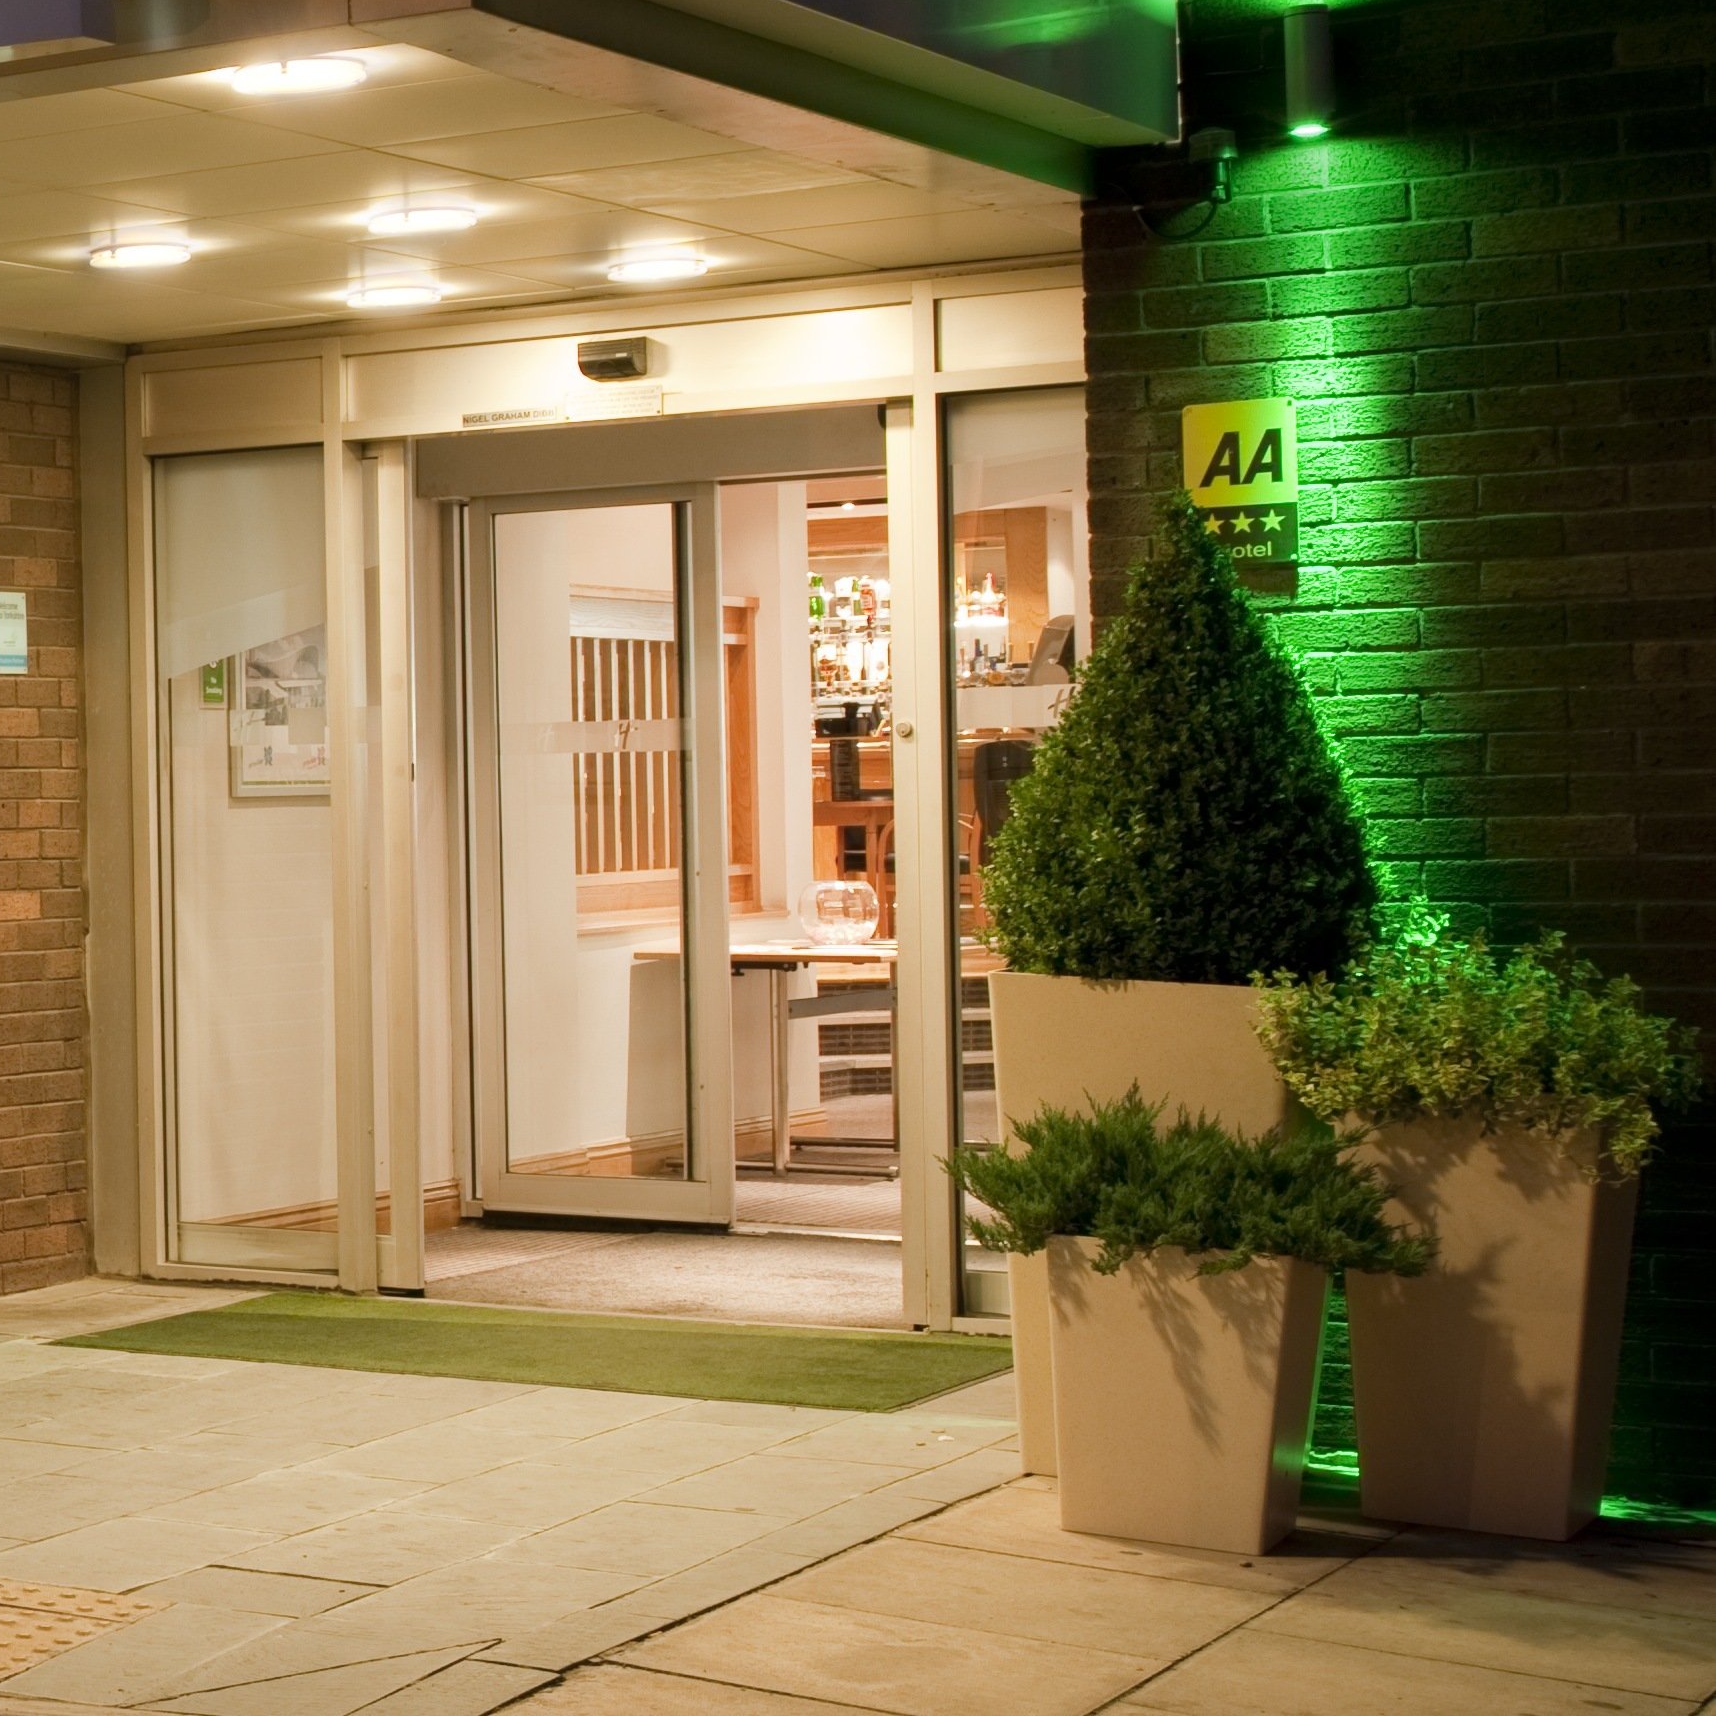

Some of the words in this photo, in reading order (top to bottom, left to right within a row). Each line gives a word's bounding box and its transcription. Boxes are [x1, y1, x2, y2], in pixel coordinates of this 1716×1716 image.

[463, 414, 489, 424] NIGEL
[491, 410, 531, 422] GRAHAM
[1199, 427, 1284, 488] AA
[1228, 540, 1273, 559] otel
